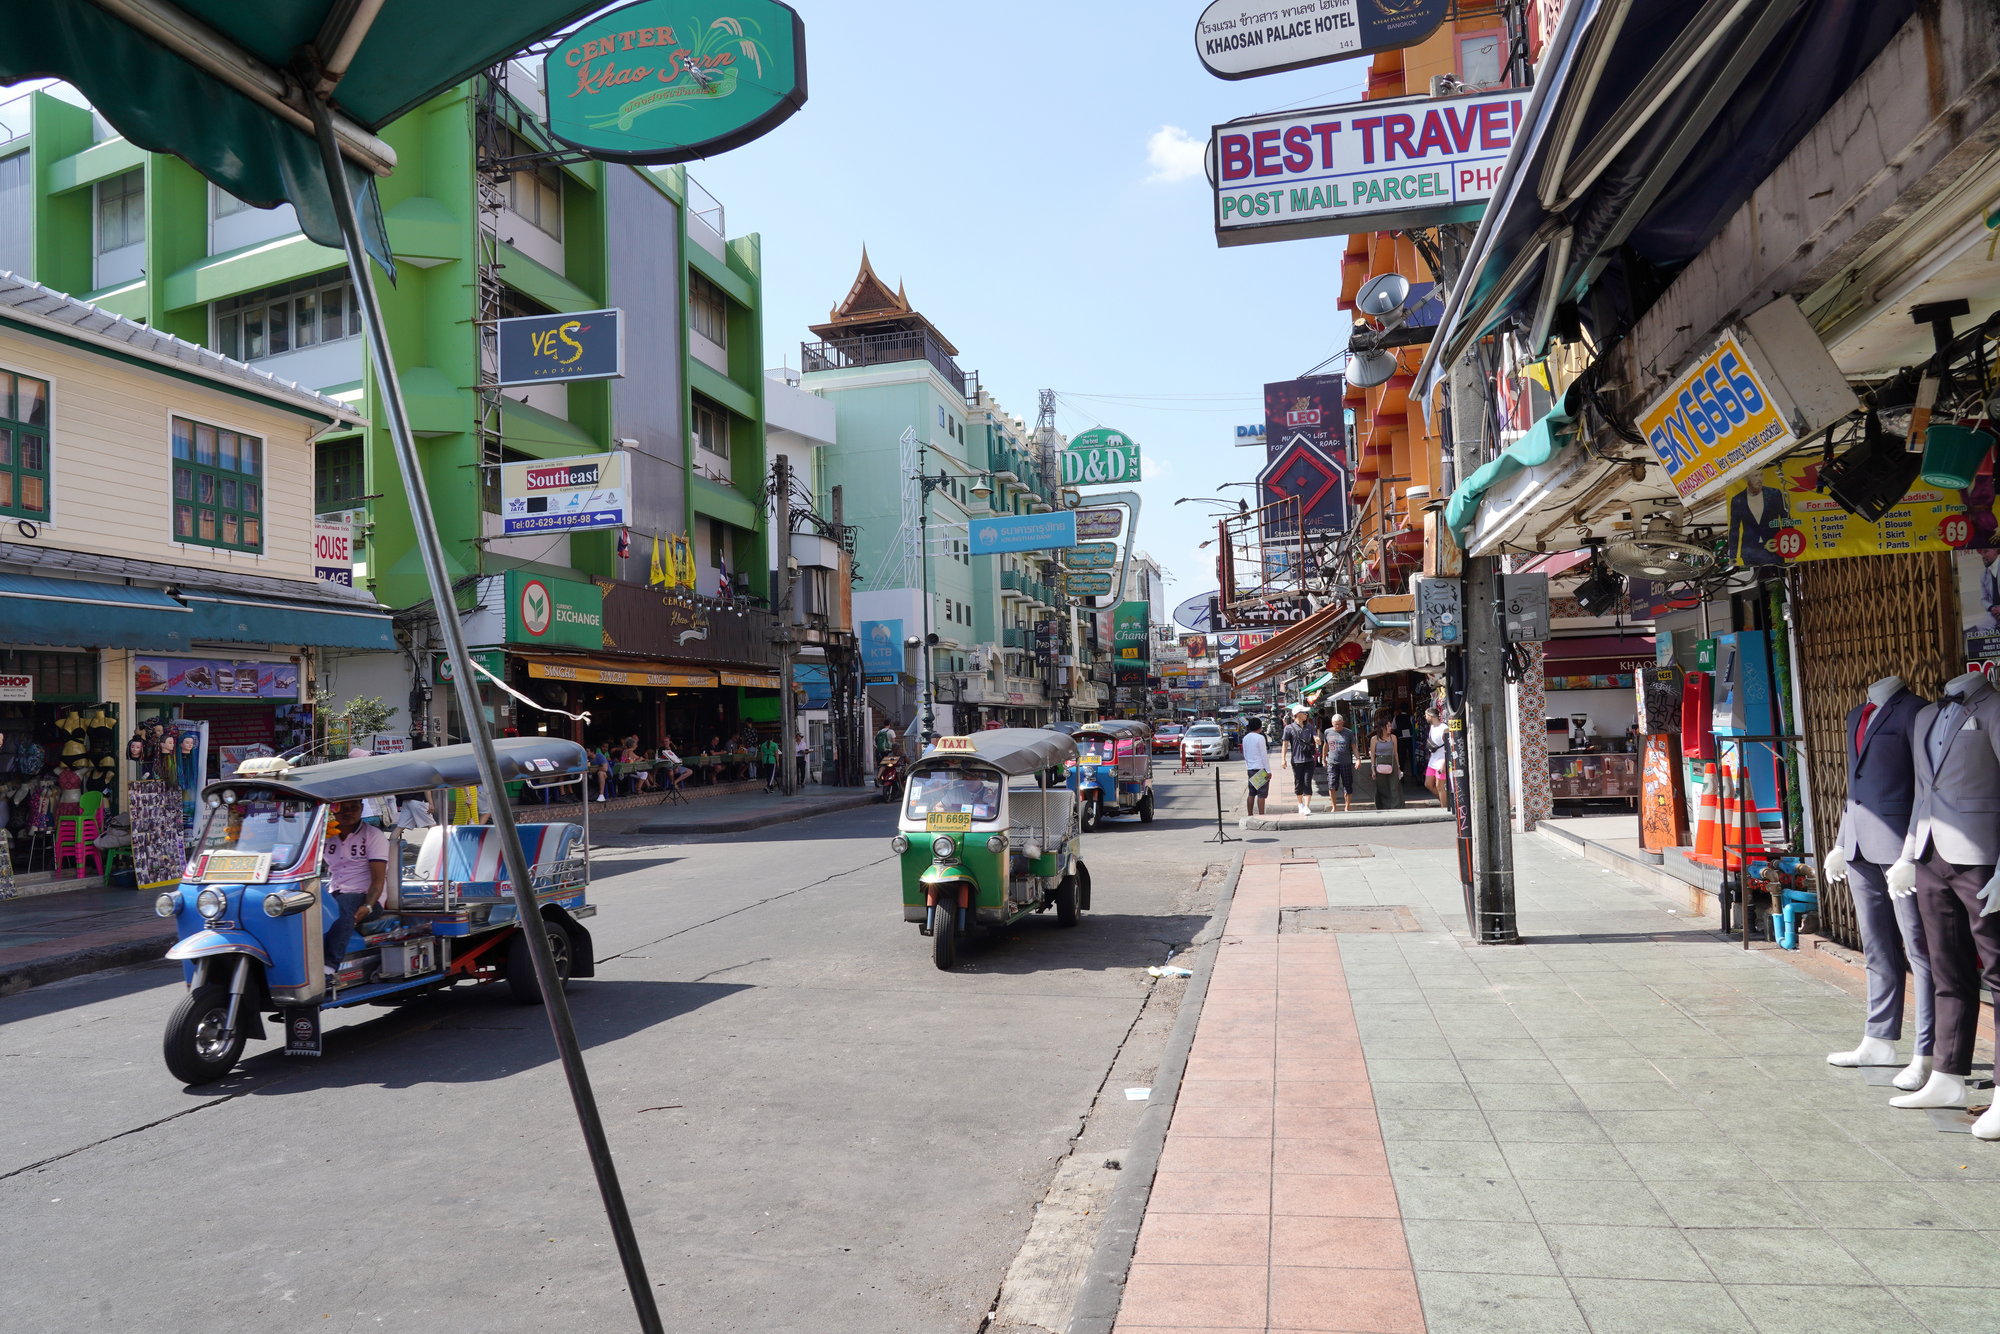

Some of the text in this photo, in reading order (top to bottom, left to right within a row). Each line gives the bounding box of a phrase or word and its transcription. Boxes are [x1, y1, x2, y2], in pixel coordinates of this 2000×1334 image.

[1200, 18, 1237, 35] โรงแรม
[1240, 11, 1279, 29] ข้าวสาร
[1387, 19, 1418, 30] BANGKOK
[1206, 11, 1355, 55] KHAOSAN PALACE HOTEL
[565, 26, 677, 68] CENTER
[1340, 40, 1354, 49] 141
[567, 61, 654, 98] Khao
[1221, 121, 1342, 181] BEST
[1222, 173, 1449, 221] POST MAIL PARCEL
[531, 320, 584, 364] YES
[534, 366, 583, 375] KAOSAN
[1287, 411, 1320, 426] LEO
[1650, 351, 1764, 476] SKY6666
[1129, 446, 1139, 478] INN
[1677, 468, 1706, 496] KHAOSAN
[1714, 457, 1731, 470] Very
[1726, 447, 1747, 464] strong
[1739, 435, 1761, 455] bucket
[1759, 418, 1784, 445] cocktail
[1064, 448, 1125, 484] D&D
[527, 467, 598, 488] Southeast
[1806, 501, 1822, 510] For
[1901, 492, 1935, 502] Ladie's
[1884, 510, 1911, 519] Jacket
[1931, 504, 1967, 513] all From
[1769, 519, 1780, 528] all
[1820, 514, 1847, 523] Jacket
[1885, 520, 1912, 529] Blouse
[1820, 523, 1844, 531] Pants
[1822, 531, 1842, 539] Shirt
[1885, 530, 1905, 539] Skirt
[1886, 541, 1910, 549] Pants
[318, 570, 348, 585] PLACE
[556, 609, 600, 627] EXCHANGE
[1115, 630, 1148, 641] Chang
[870, 648, 892, 658] KTB
[544, 664, 577, 680] SINGHA
[599, 669, 628, 683] SINGHA
[647, 673, 671, 686] SINGHA
[942, 739, 968, 749] TAXI
[946, 814, 970, 824] 6695
[351, 845, 367, 856] 53
